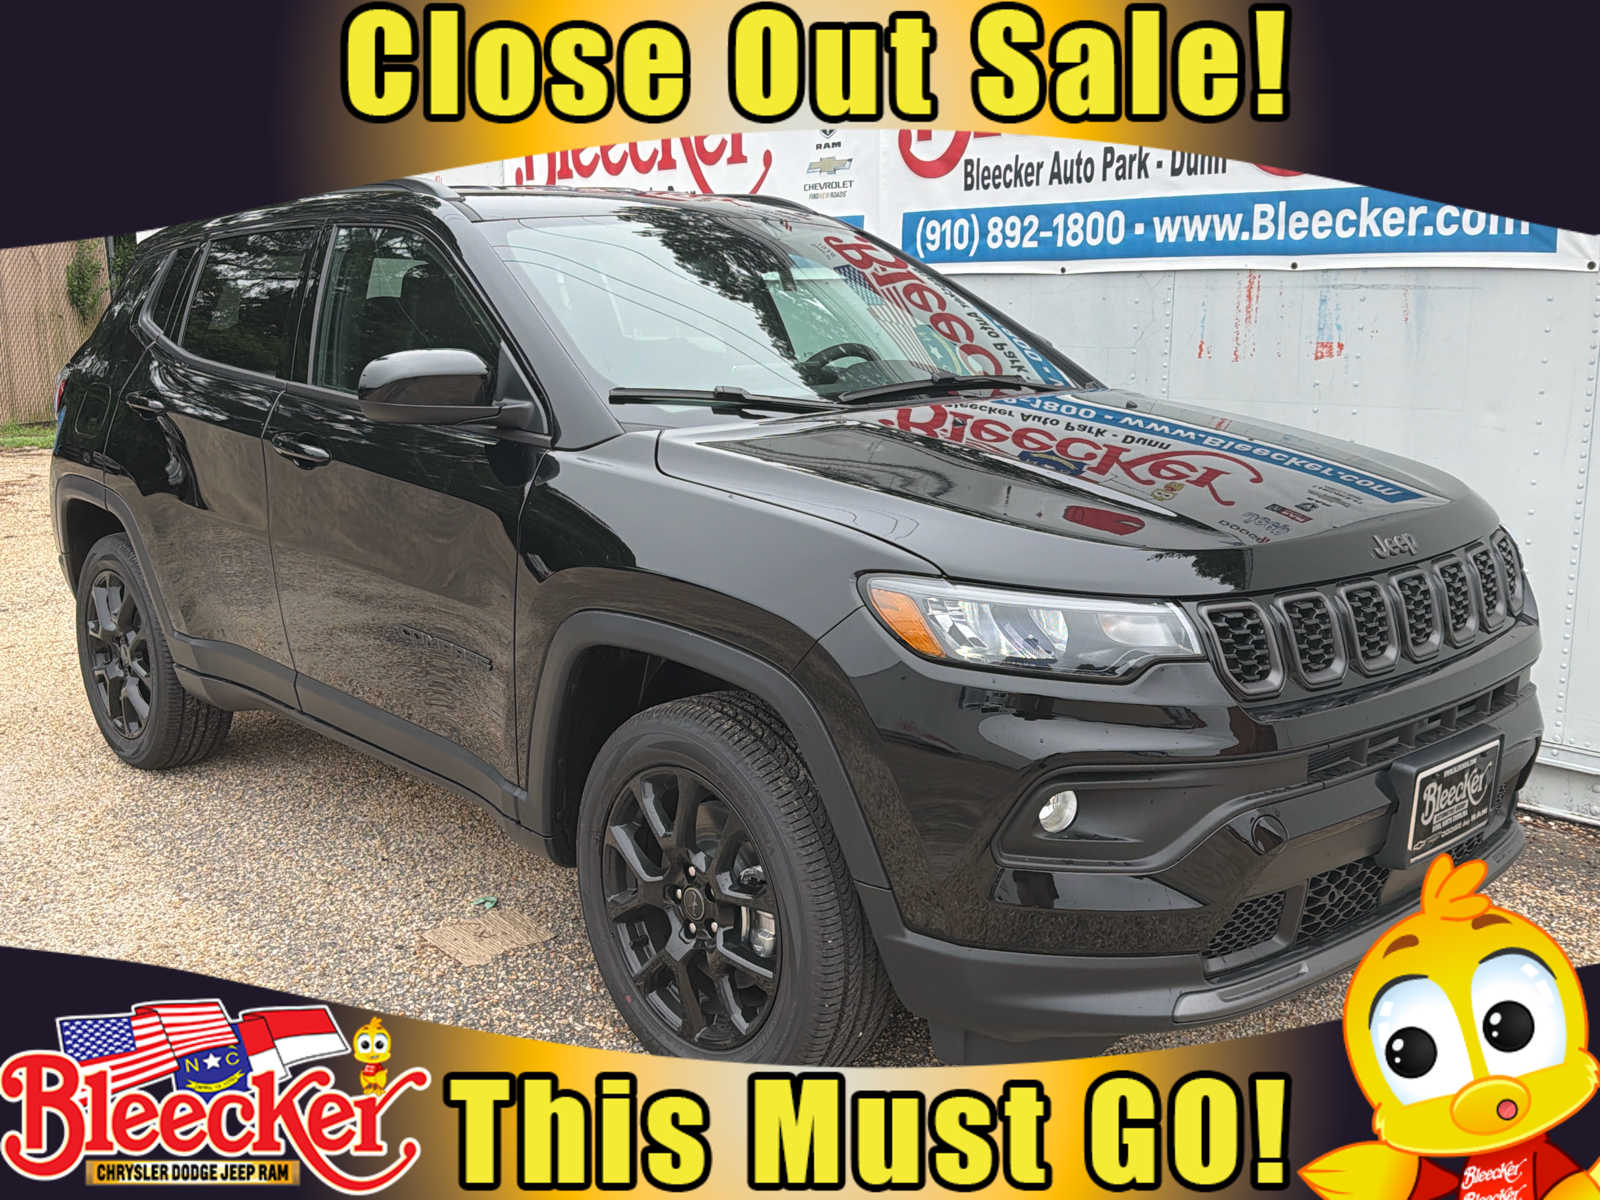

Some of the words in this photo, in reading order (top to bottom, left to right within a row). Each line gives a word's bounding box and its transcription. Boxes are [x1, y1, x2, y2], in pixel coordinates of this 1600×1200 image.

[816, 141, 842, 150] RAM
[963, 154, 1045, 191] Bleecker
[1049, 151, 1095, 186] Auto
[1102, 145, 1150, 182] Park
[803, 180, 854, 191] CHEVROLET
[916, 213, 980, 258] (910)
[986, 209, 1126, 249] 892-1800
[1152, 196, 1530, 243] www.Bleecker.com
[1371, 533, 1417, 559] Jeep
